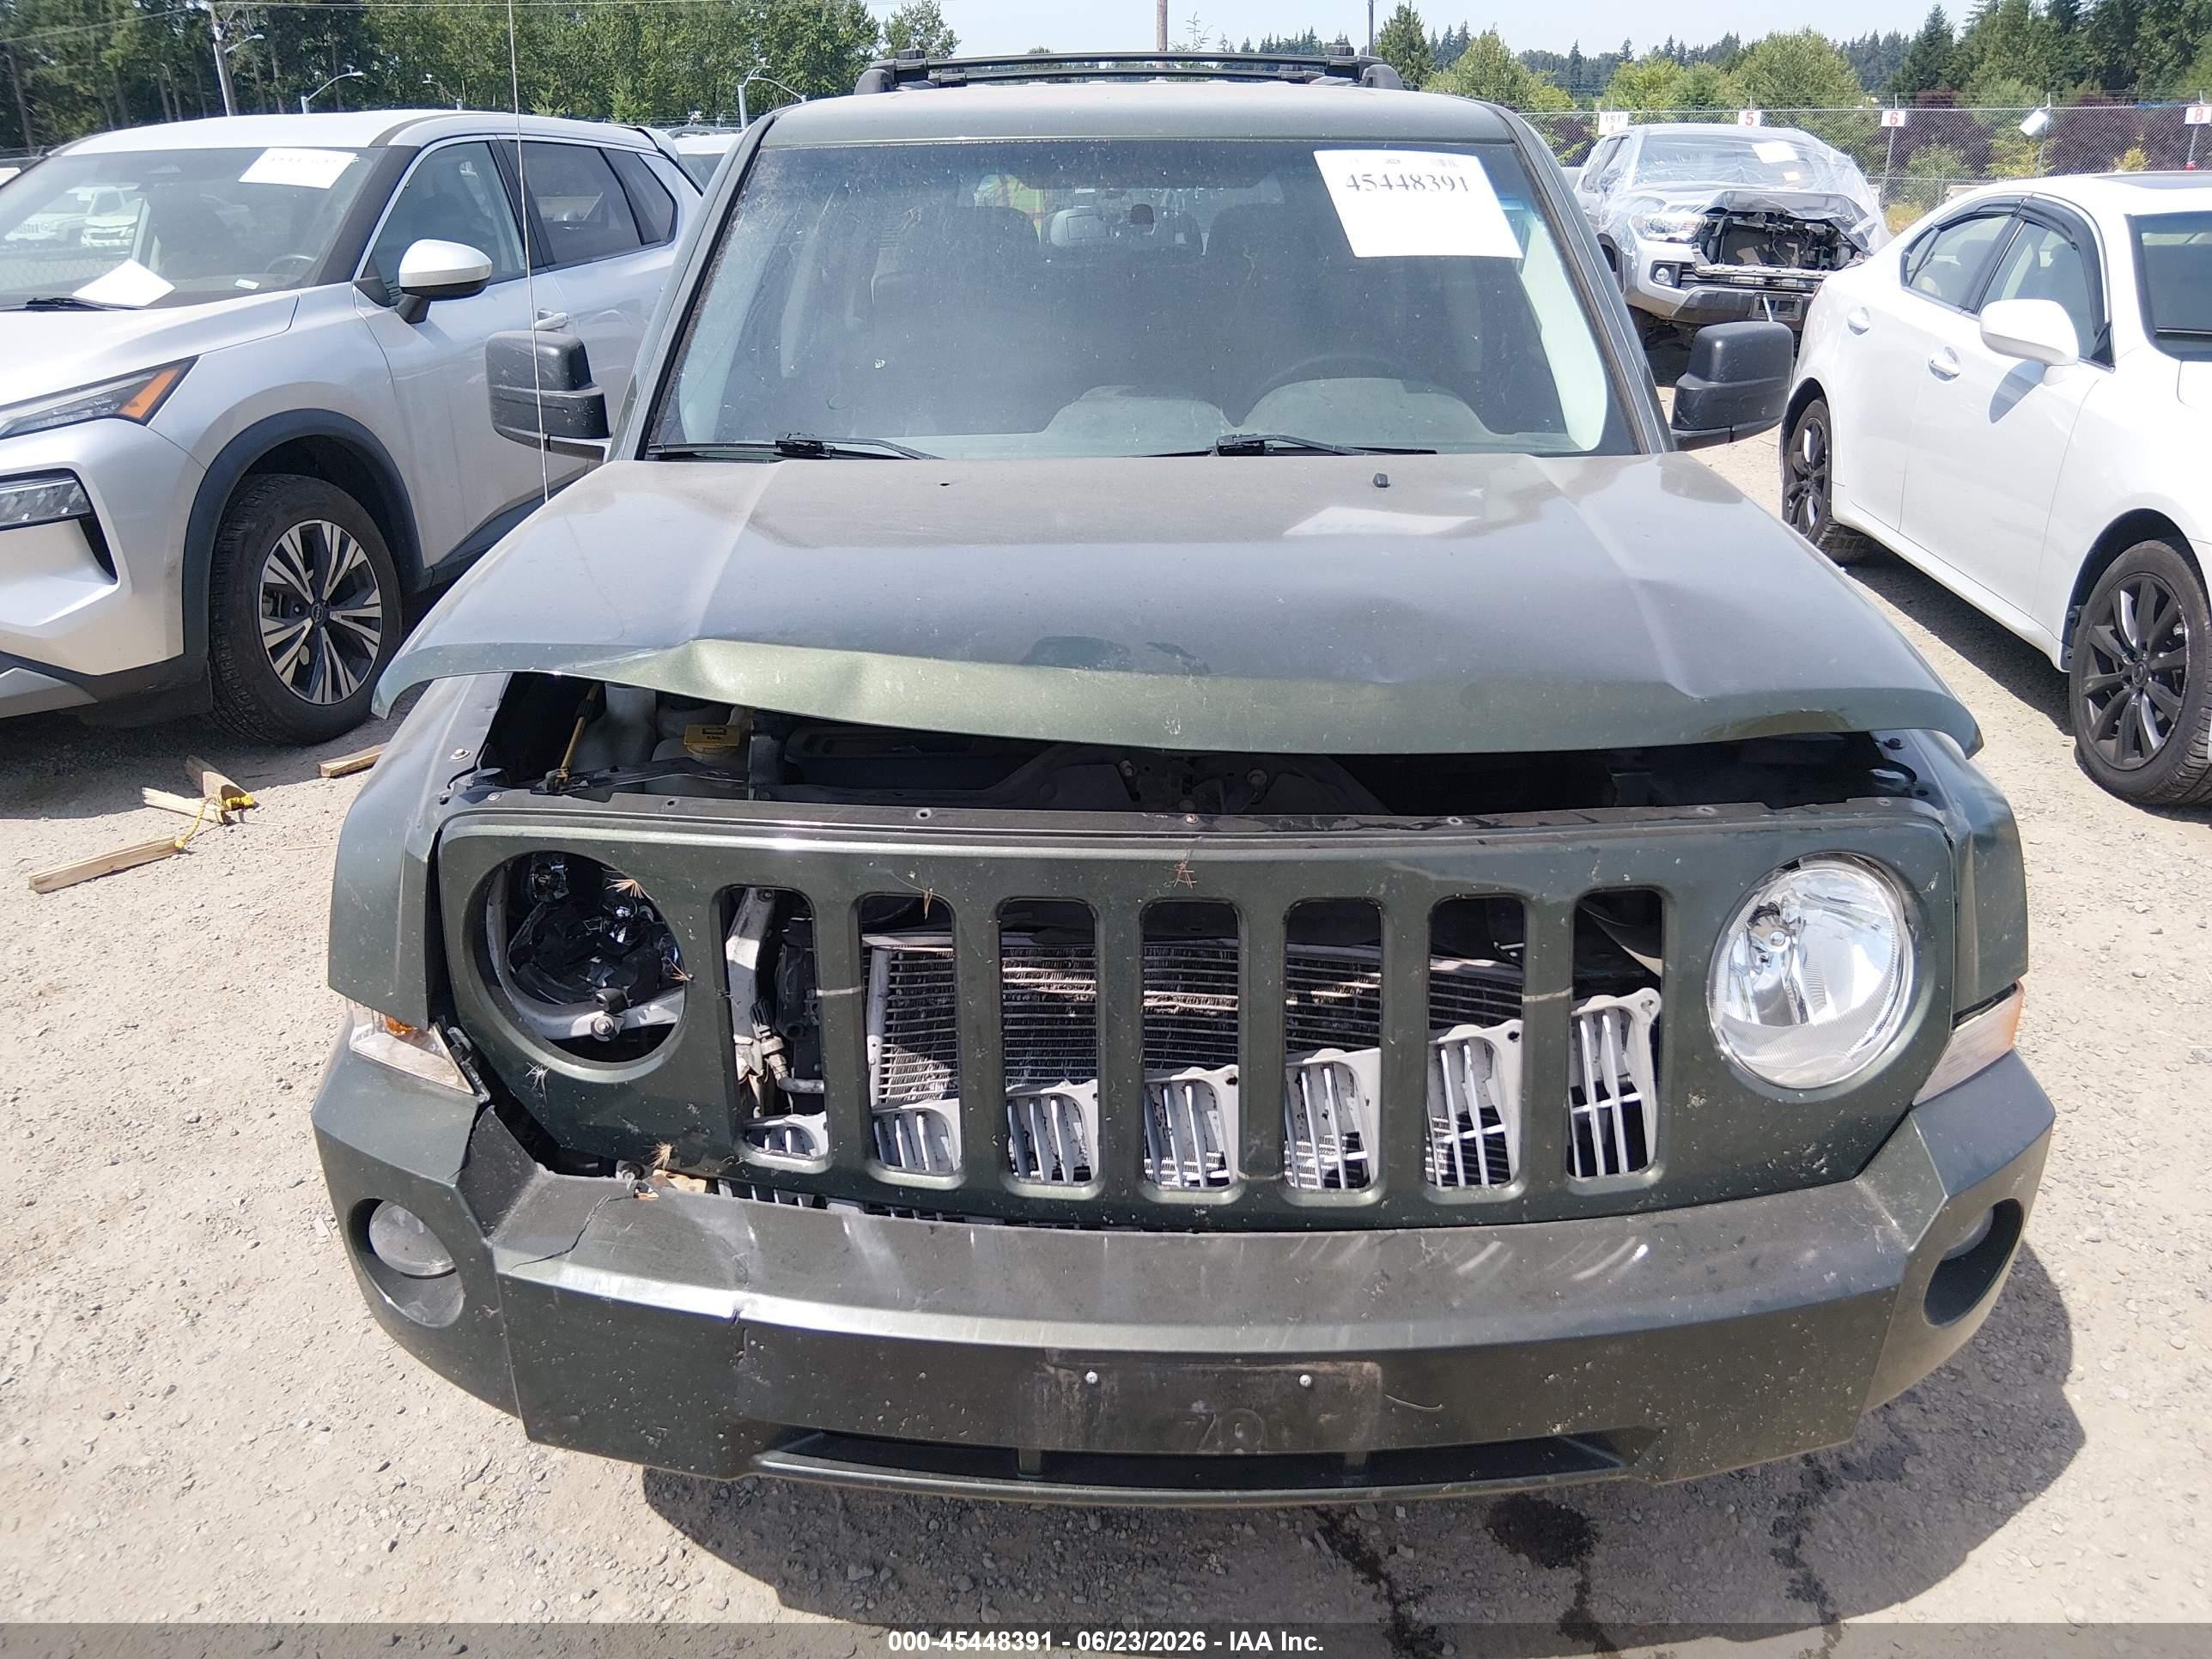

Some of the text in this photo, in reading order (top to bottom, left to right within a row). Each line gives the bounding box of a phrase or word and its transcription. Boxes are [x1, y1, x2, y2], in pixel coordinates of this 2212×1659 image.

[1745, 112, 1754, 125] 5
[1889, 112, 1899, 125] 6
[2194, 108, 2203, 123] 8
[1346, 173, 1468, 191] 45448391
